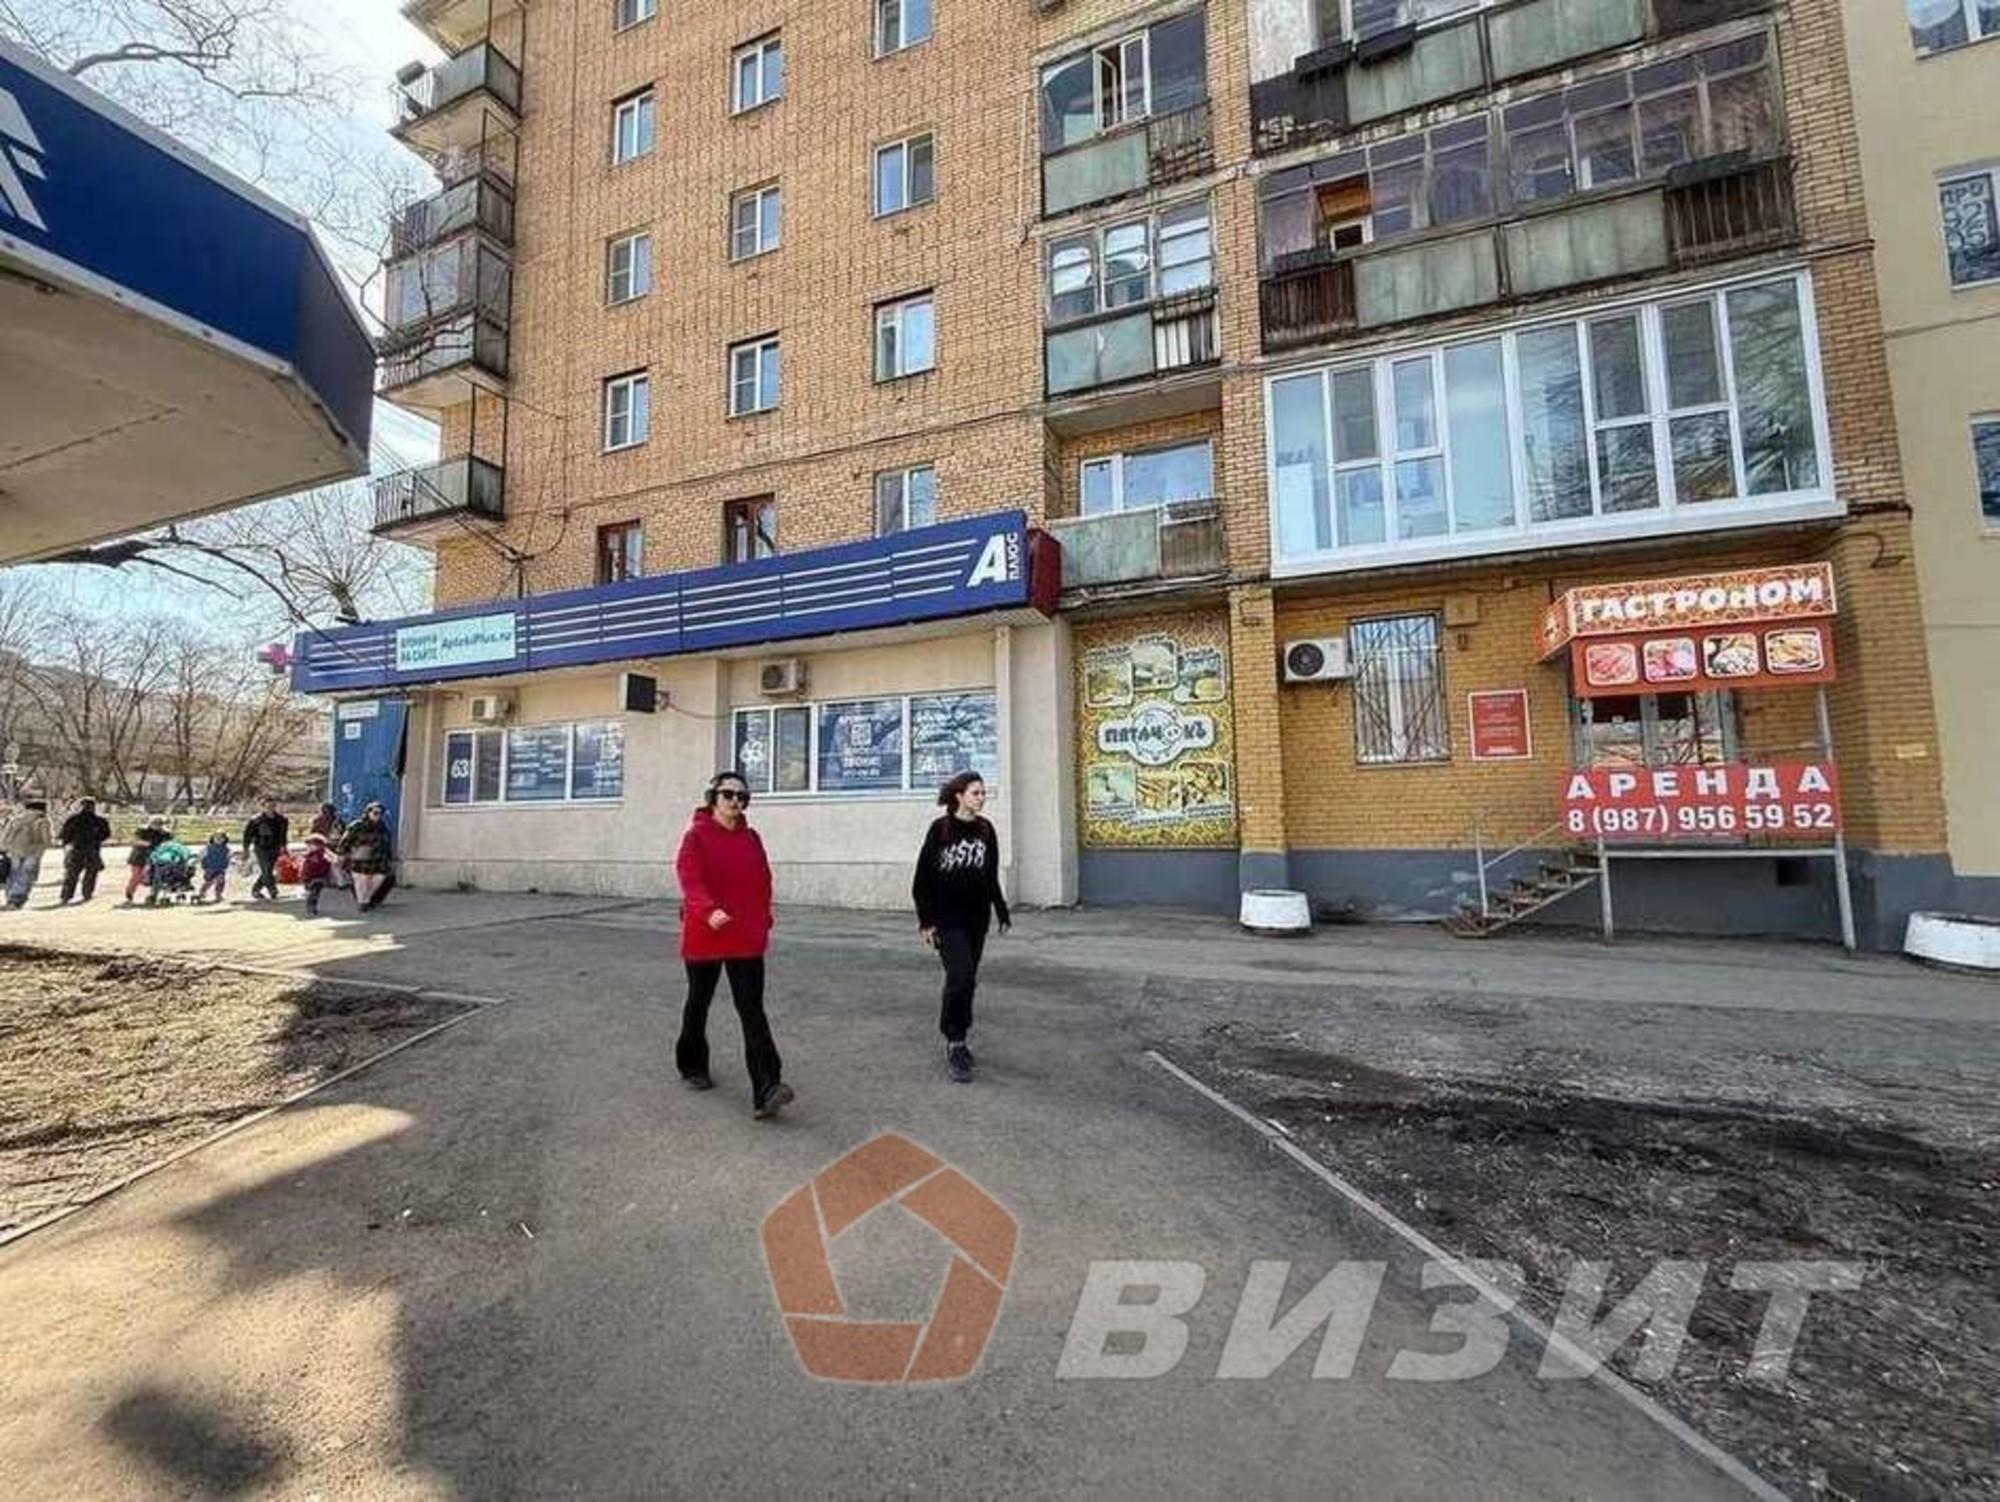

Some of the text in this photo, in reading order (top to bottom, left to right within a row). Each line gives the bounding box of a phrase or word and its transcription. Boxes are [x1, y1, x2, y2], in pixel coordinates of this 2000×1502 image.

[1006, 531, 1020, 580] ПЛЮС
[1582, 577, 1824, 622] ГАСТРОНОМ
[1567, 765, 1831, 800] АРЕНДА
[1568, 802, 1834, 834] 8 (987) 956 59 52
